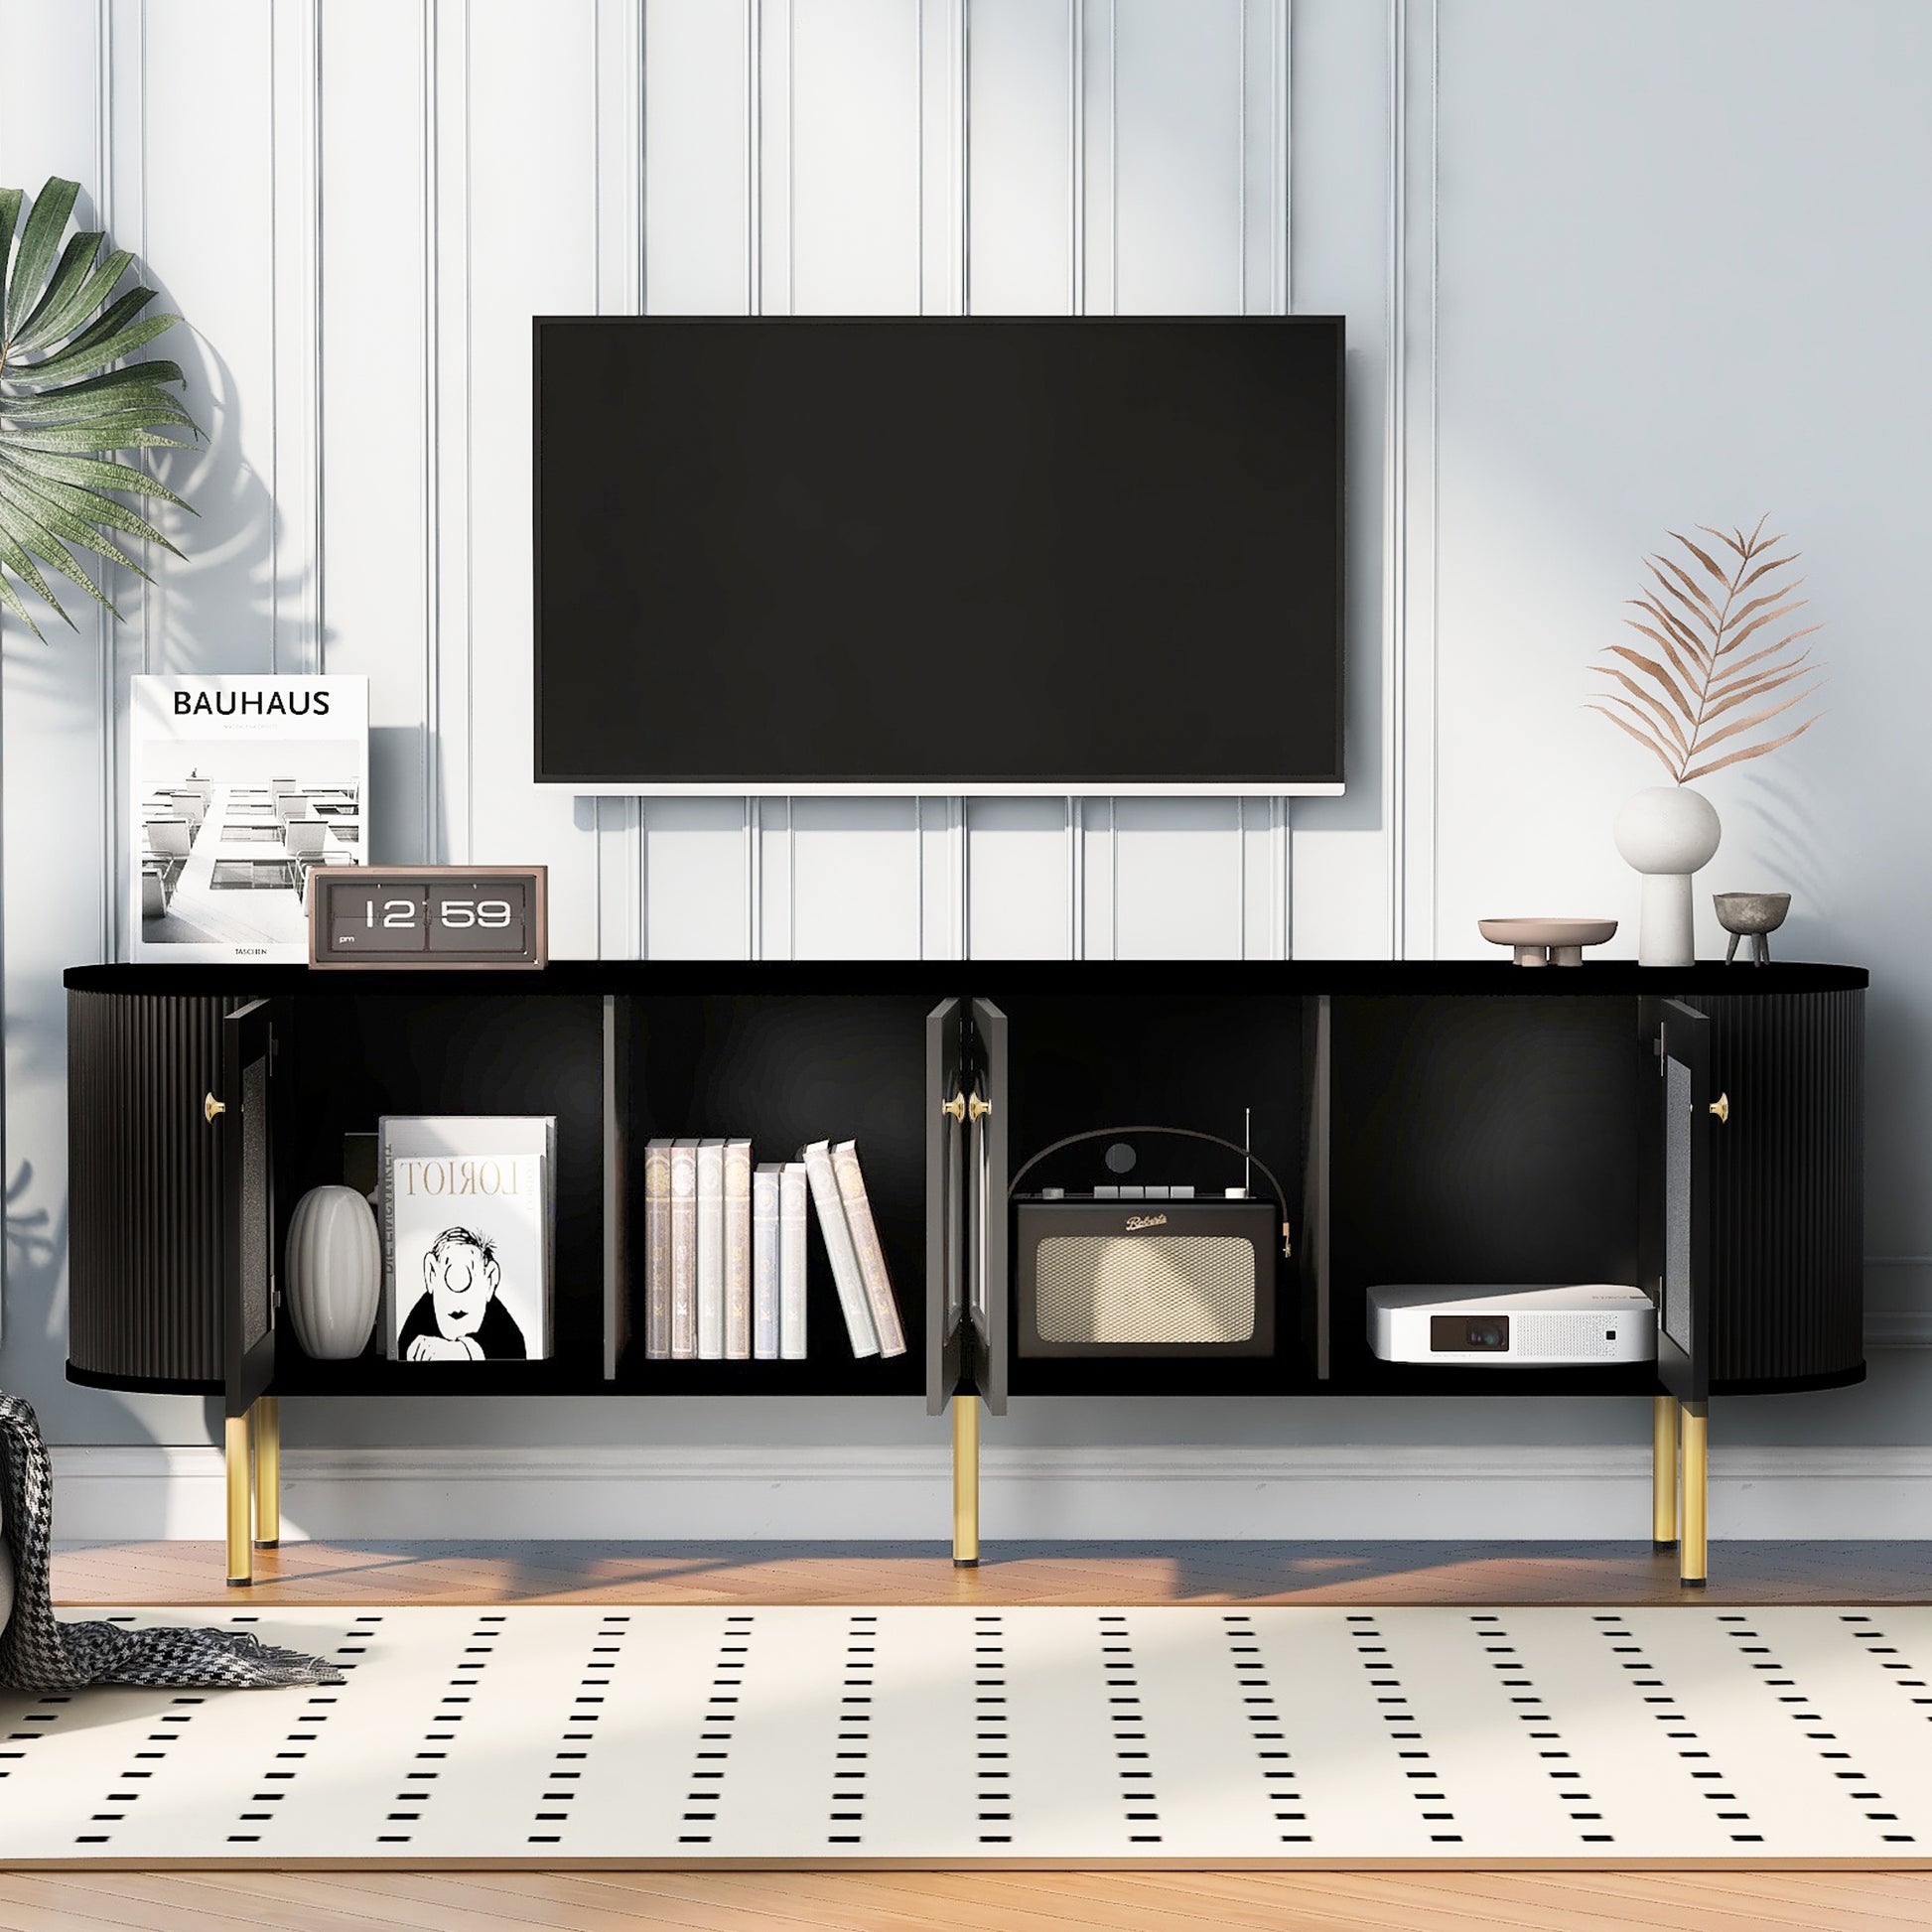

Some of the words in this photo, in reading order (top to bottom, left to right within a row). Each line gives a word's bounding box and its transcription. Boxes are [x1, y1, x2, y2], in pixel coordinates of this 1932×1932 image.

[174, 691, 330, 715] BAUHAUS
[366, 899, 415, 928] 12
[441, 899, 511, 928] 59
